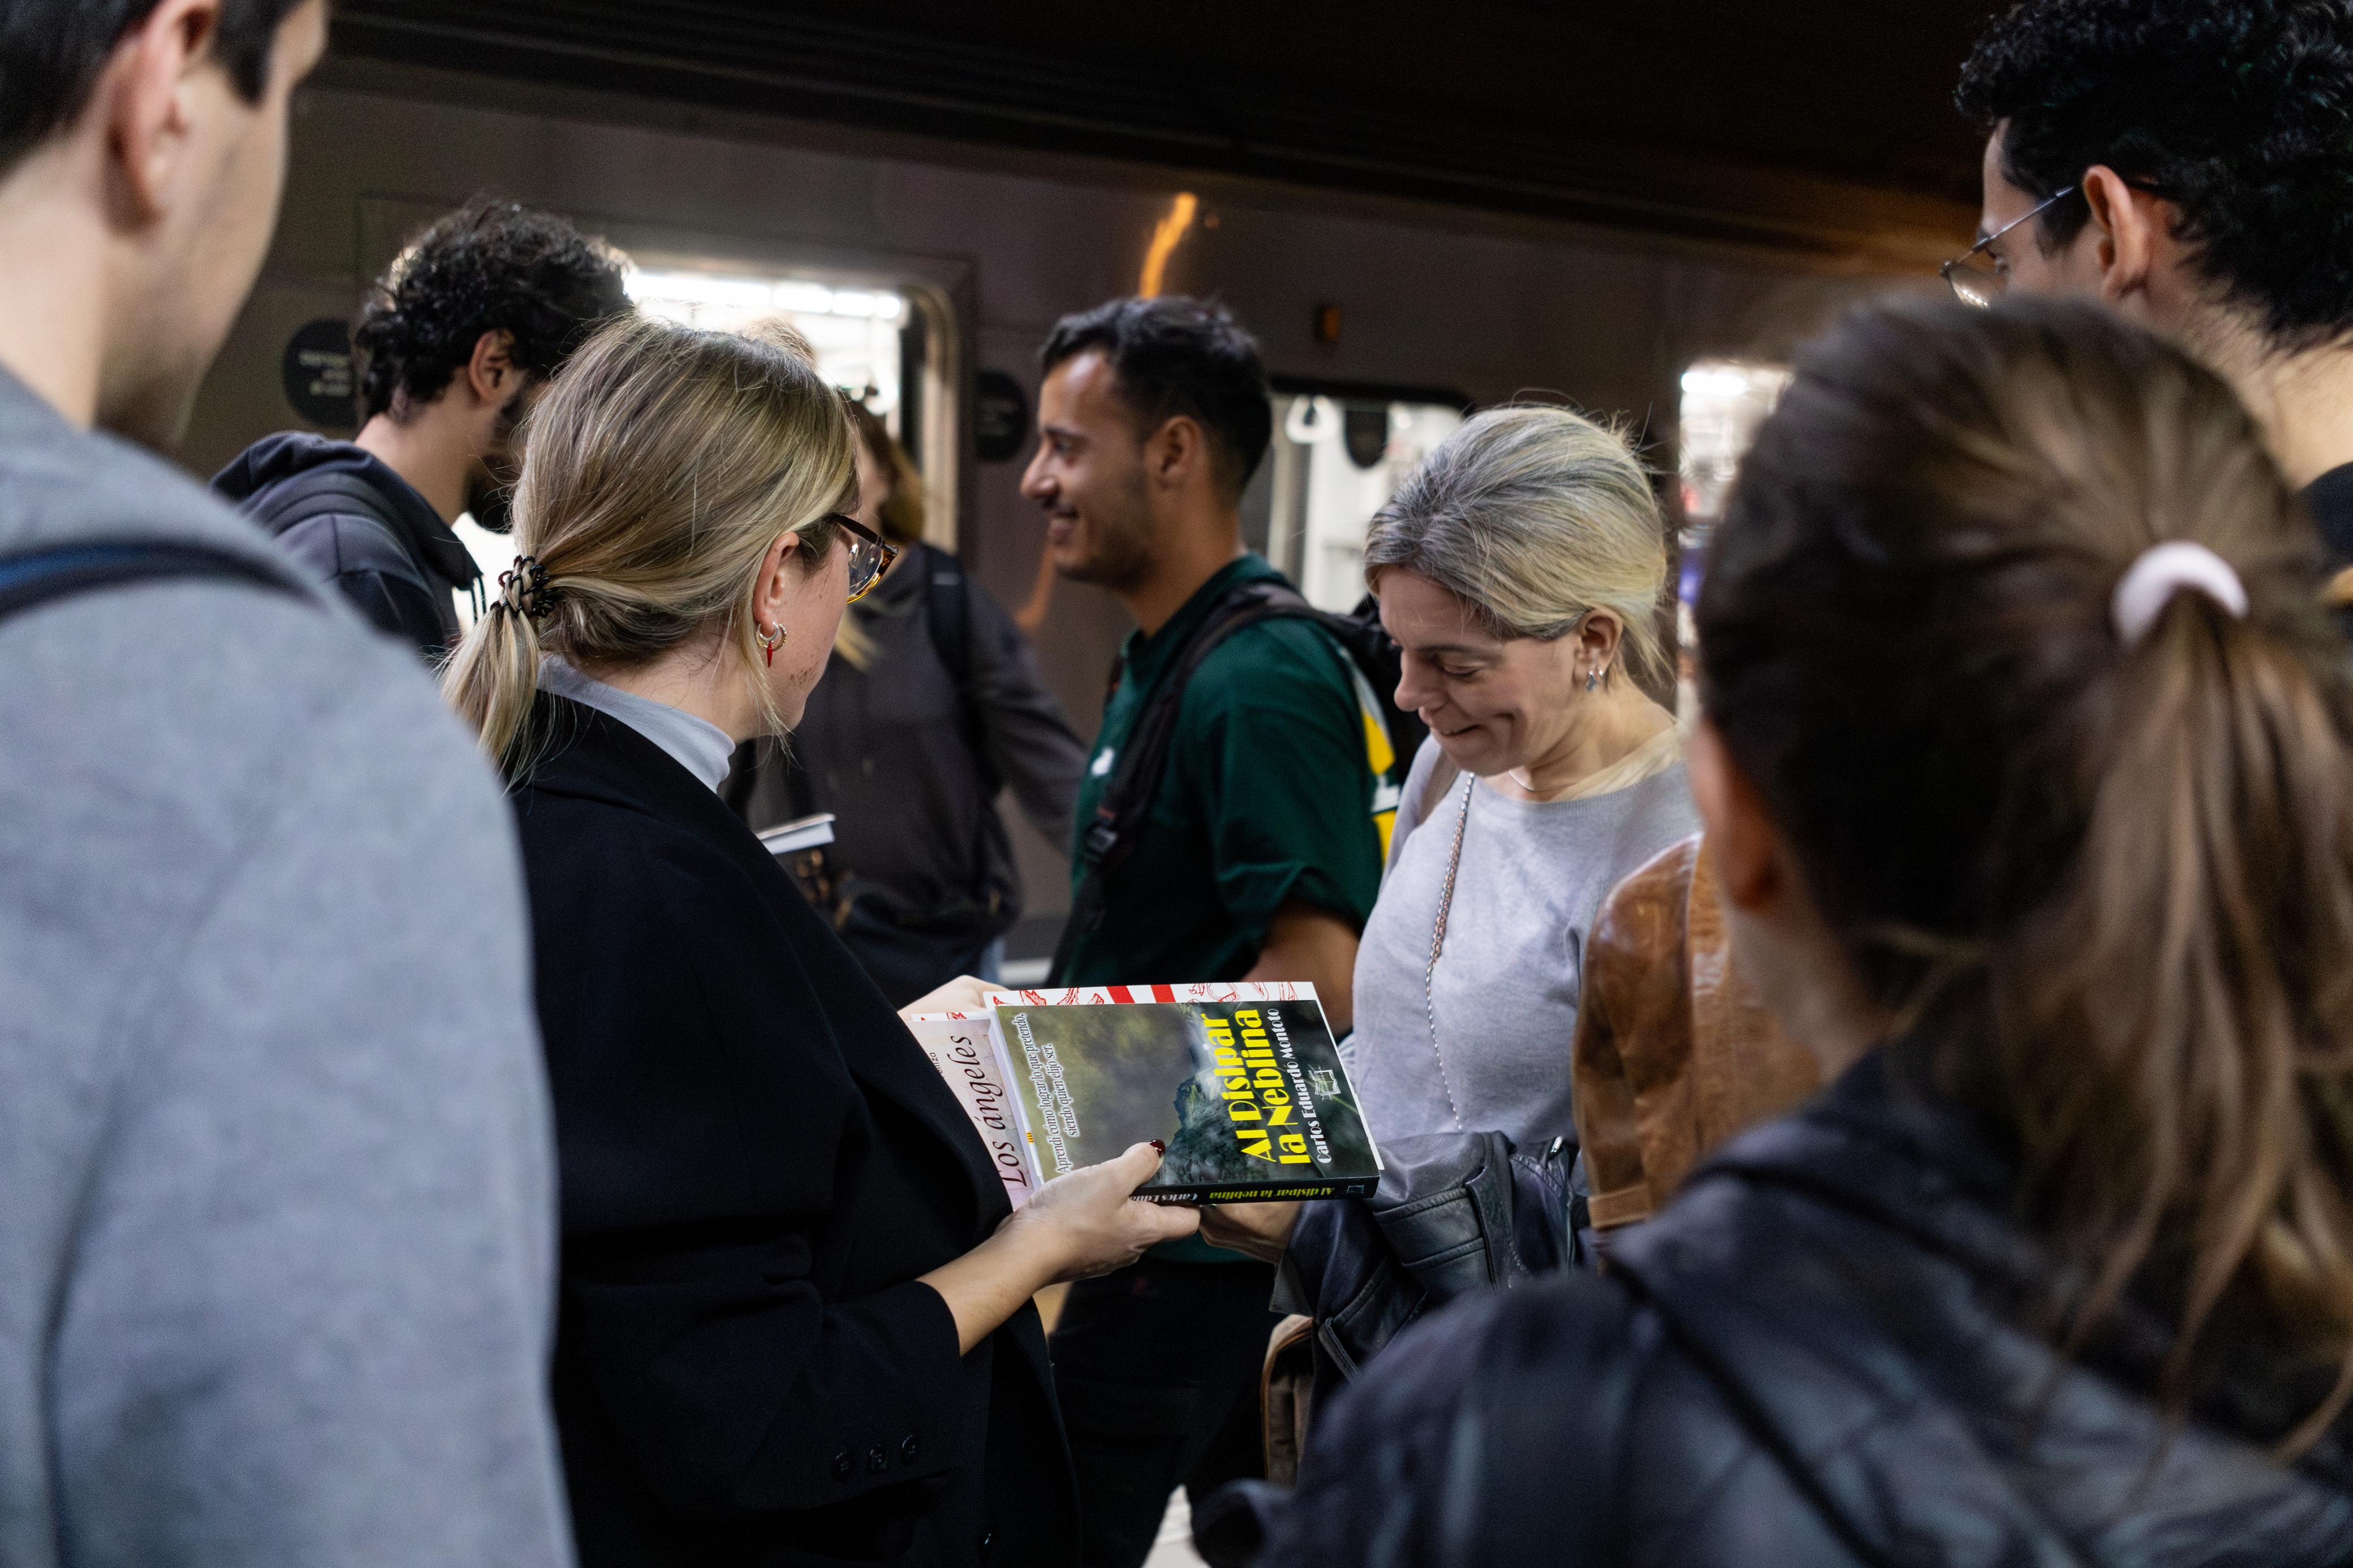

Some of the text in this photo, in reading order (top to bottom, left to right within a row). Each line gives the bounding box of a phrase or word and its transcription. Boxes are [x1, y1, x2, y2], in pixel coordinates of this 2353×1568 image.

[1014, 1014, 1038, 1052] pretendo,
[1267, 1008, 1296, 1060] Montoto
[1028, 1053, 1043, 1069] que
[1037, 1082, 1053, 1108] lograr
[1044, 1044, 1078, 1136] siendo quien elijo ser.
[1200, 1013, 1277, 1163] Al Disipar
[1235, 1009, 1312, 1164] la Neblina
[1286, 1061, 1317, 1118] Eduardo
[946, 1035, 1028, 1187] Los ángeles
[1045, 1110, 1059, 1134] cómo
[1047, 1137, 1072, 1173] Aprendí
[1308, 1120, 1332, 1164] Carlos
[1161, 1193, 1198, 1202] Carlos
[1209, 1190, 1258, 1199] neblina
[1277, 1188, 1318, 1198] disipar
[1320, 1187, 1335, 1196] Al
